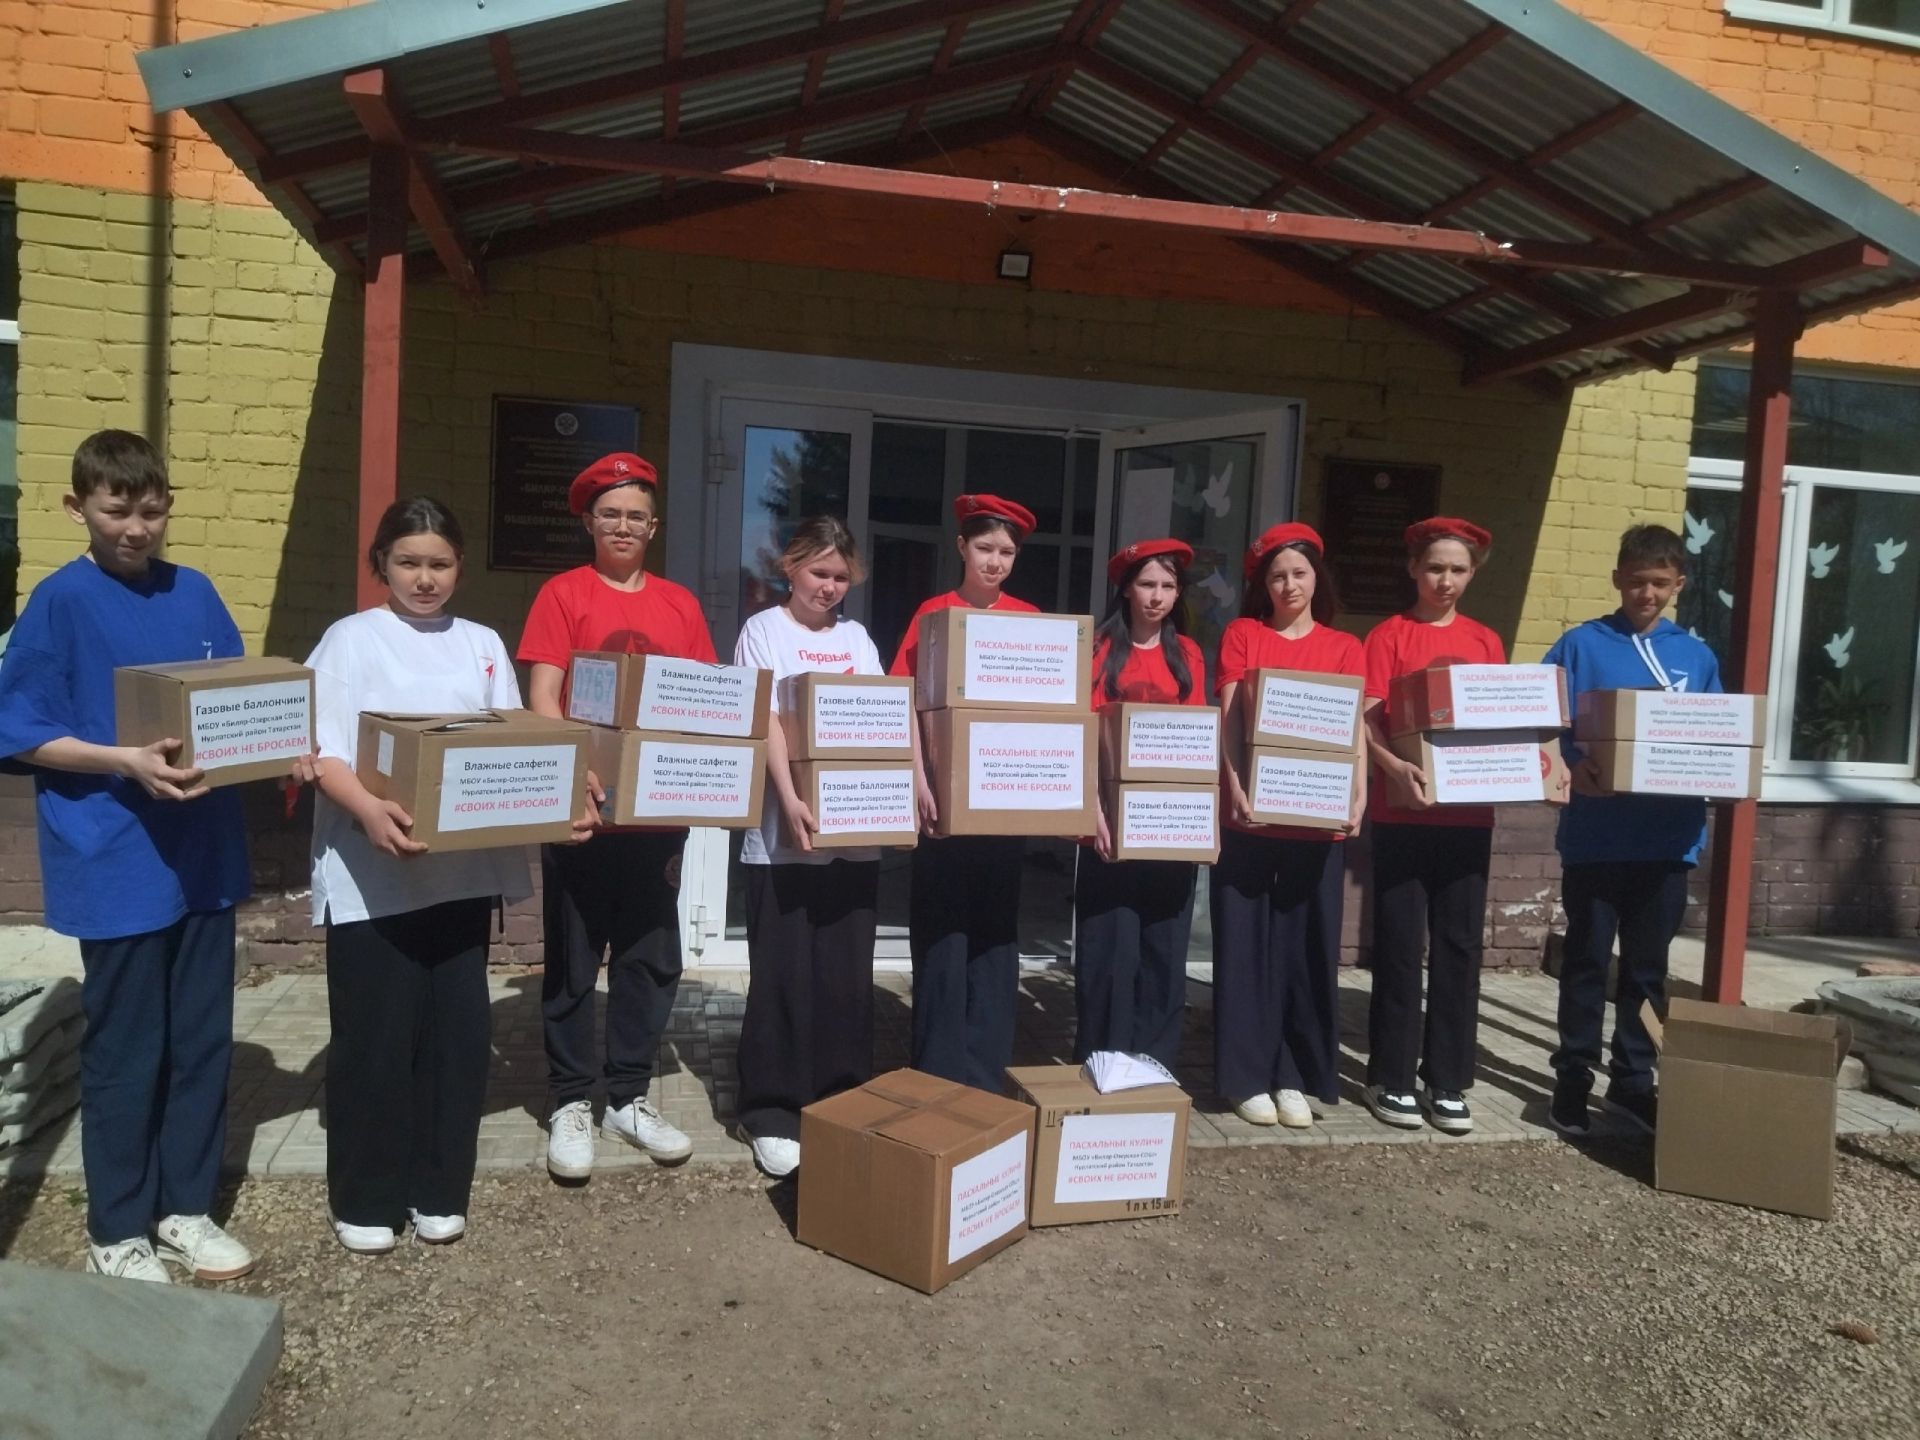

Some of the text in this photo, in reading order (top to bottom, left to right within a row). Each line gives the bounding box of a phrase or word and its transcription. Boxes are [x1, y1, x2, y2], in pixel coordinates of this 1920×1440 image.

[975, 641, 1068, 652] ПАСХАЛЬНЫЕ КУЛИЧИ
[798, 650, 852, 664] Первые
[662, 669, 741, 685] Влажные салфетки
[1025, 677, 1064, 686] БРОСАЕМ
[856, 697, 906, 706] баллончики
[1267, 688, 1353, 706] Газовые баллончики
[196, 696, 305, 716] Газовые баллончики
[651, 705, 741, 721] #СВОИХ НЕ БРОСАЕМ
[198, 722, 219, 731] МБОУ
[1310, 726, 1349, 736] БРОСАЕМ
[202, 724, 301, 743] Нурлатский район Татарстан
[194, 736, 306, 762] #СВОИХ НЕ БРОСАЕМ
[979, 748, 1037, 757] ПАСХАЛЬНЫЕ
[657, 755, 737, 766] Влажные салфетки
[1176, 754, 1213, 762] БРОСАЕМ
[465, 760, 557, 770] Влажные салфетки
[1261, 767, 1347, 780] Газовые баллончики
[462, 788, 501, 796] Нурлатский
[1030, 783, 1071, 792] БРОСАЕМ
[649, 792, 684, 800] #СВОИХ
[699, 793, 738, 802] БРОСАЕМ
[455, 798, 558, 812] #СВОИХ НЕ БРОСАЕМ
[1163, 802, 1210, 810] баллончики
[1305, 802, 1346, 812] БРОСАЕМ
[871, 816, 910, 824] БРОСАЕМ
[1070, 1140, 1126, 1149] ПАСХАЛЬНЫЕ
[1117, 1172, 1157, 1181] БРОСАЕМ
[1126, 1200, 1130, 1211] 1
[1151, 1197, 1161, 1210] 15
[1164, 1200, 1177, 1209] шт.
